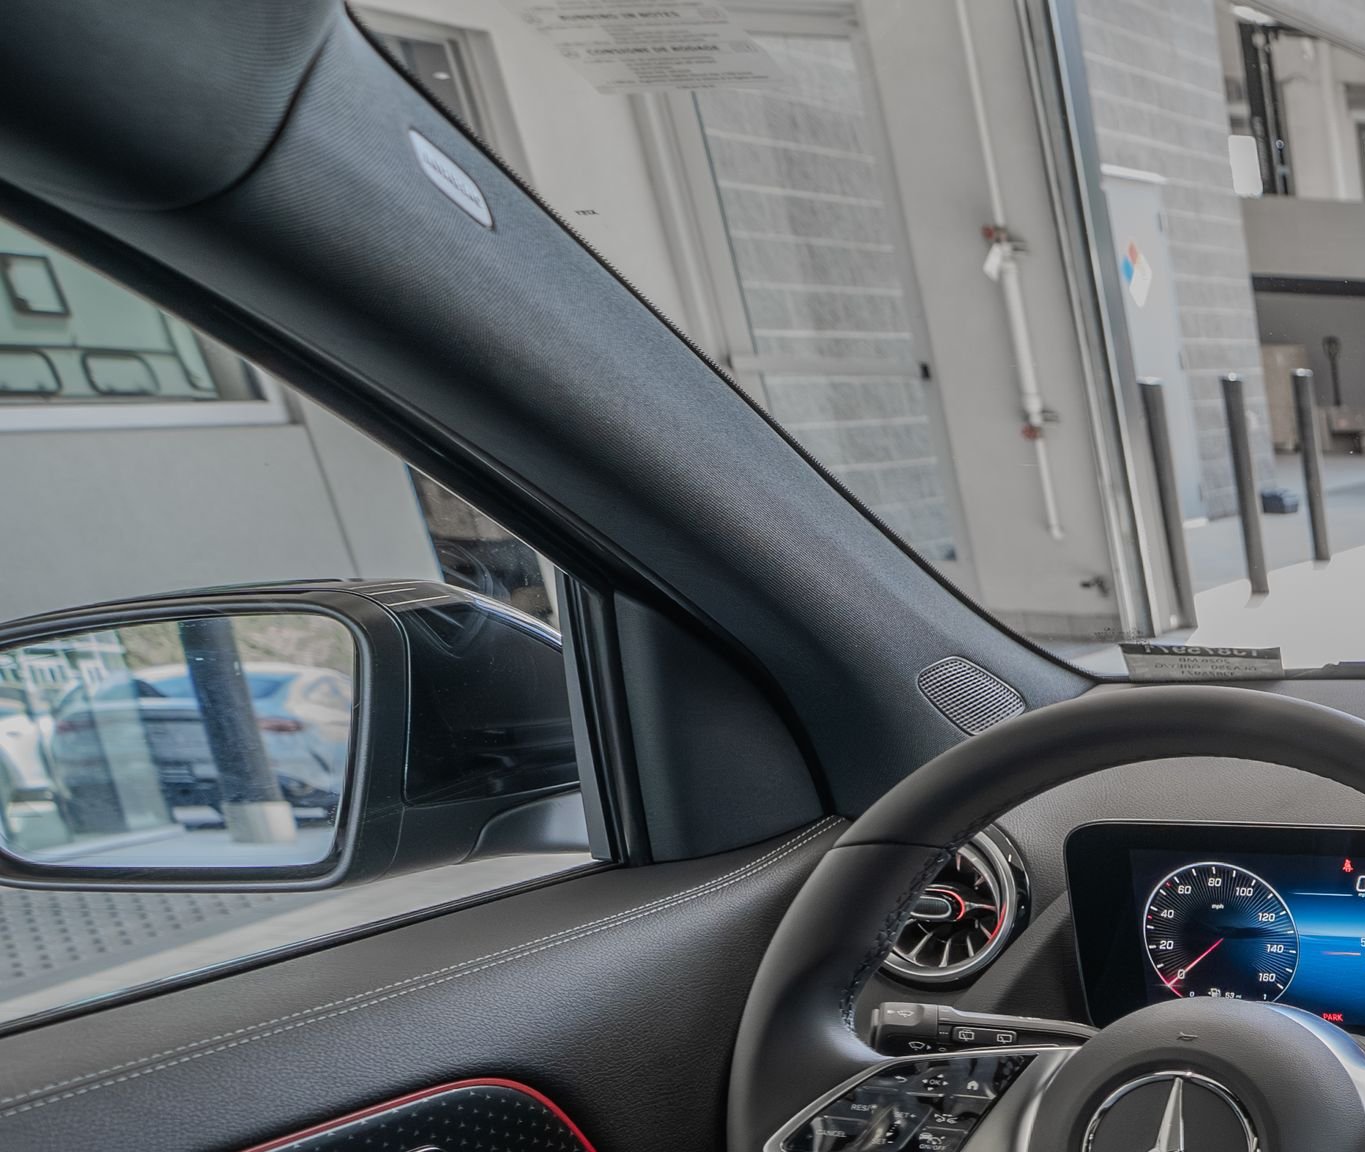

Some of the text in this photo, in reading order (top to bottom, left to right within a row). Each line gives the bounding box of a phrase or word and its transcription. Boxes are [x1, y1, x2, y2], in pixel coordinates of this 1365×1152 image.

[1208, 878, 1221, 887] 80
[1178, 886, 1191, 894] 60
[1236, 888, 1253, 896] 100
[1161, 909, 1174, 918] 40
[1258, 913, 1275, 921] 120
[1160, 941, 1173, 950] 20
[1267, 944, 1284, 953] 140
[1178, 969, 1185, 979] 0
[1259, 973, 1276, 982] 160
[1323, 1013, 1343, 1022] PARK
